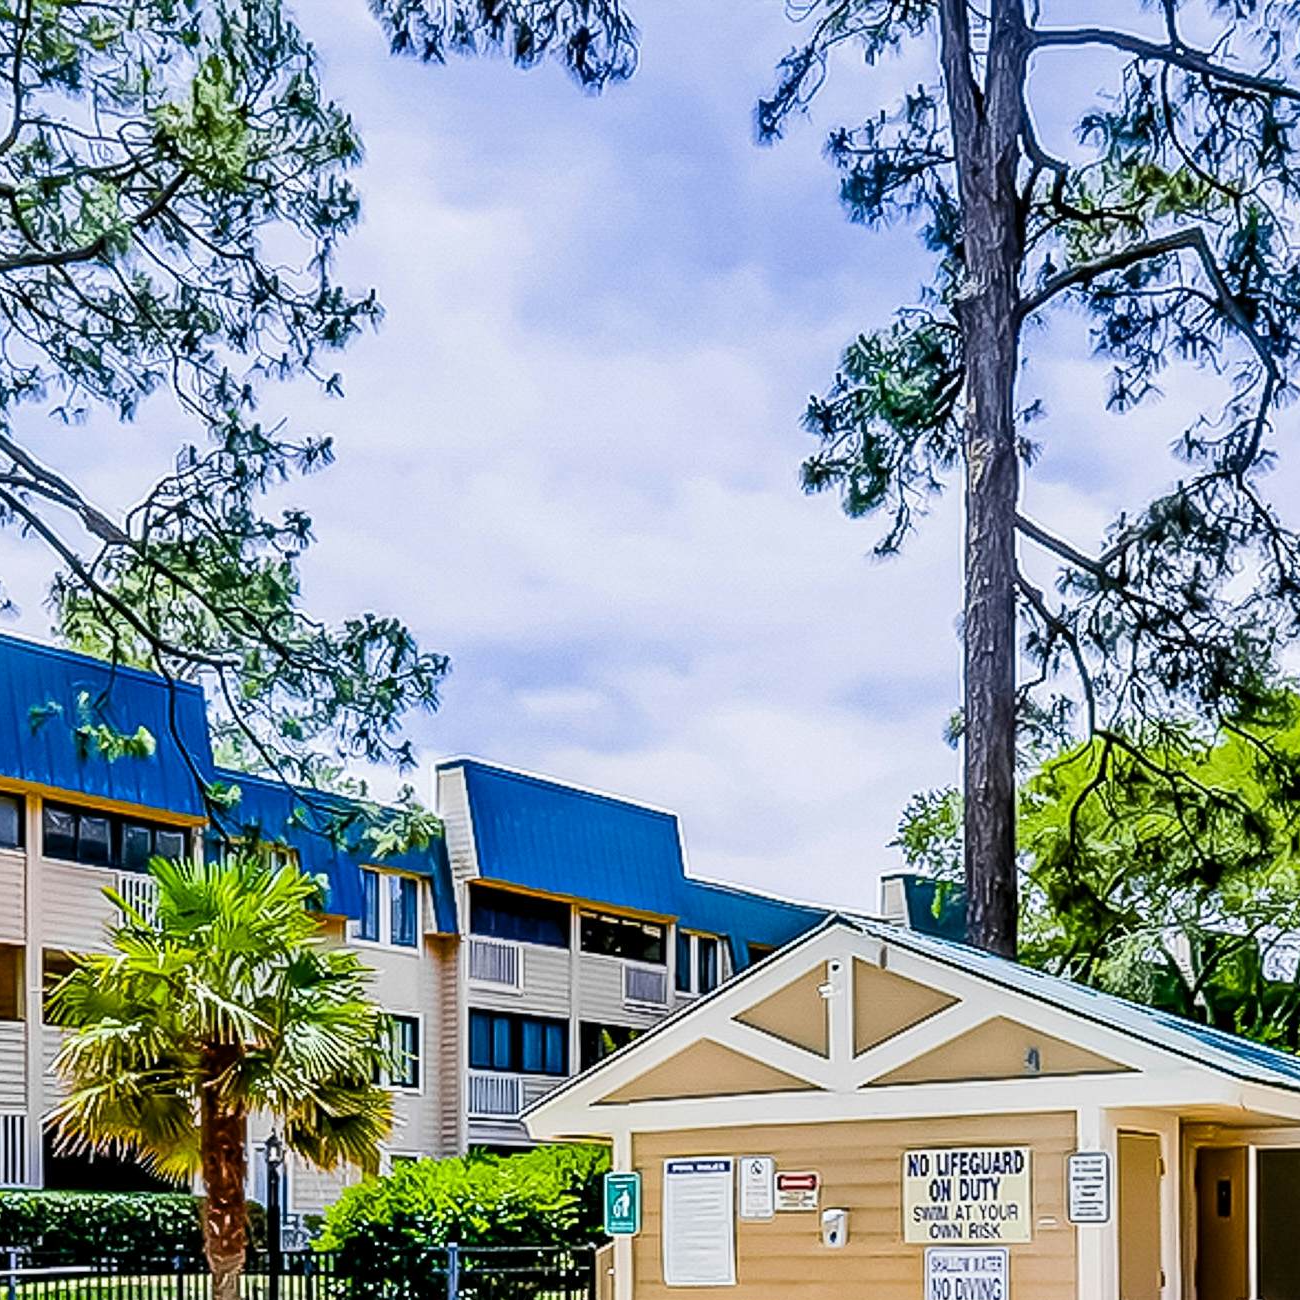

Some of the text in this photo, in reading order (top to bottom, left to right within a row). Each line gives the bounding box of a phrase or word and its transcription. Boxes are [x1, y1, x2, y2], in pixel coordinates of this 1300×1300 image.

[907, 1150, 1024, 1176] NO LIFEGUARD
[929, 1177, 1000, 1202] ON DUTY
[913, 1203, 1018, 1222] SWIM AT YOUR
[929, 1222, 1002, 1238] OWN RISK
[932, 1278, 1002, 1300] NO DIVING
